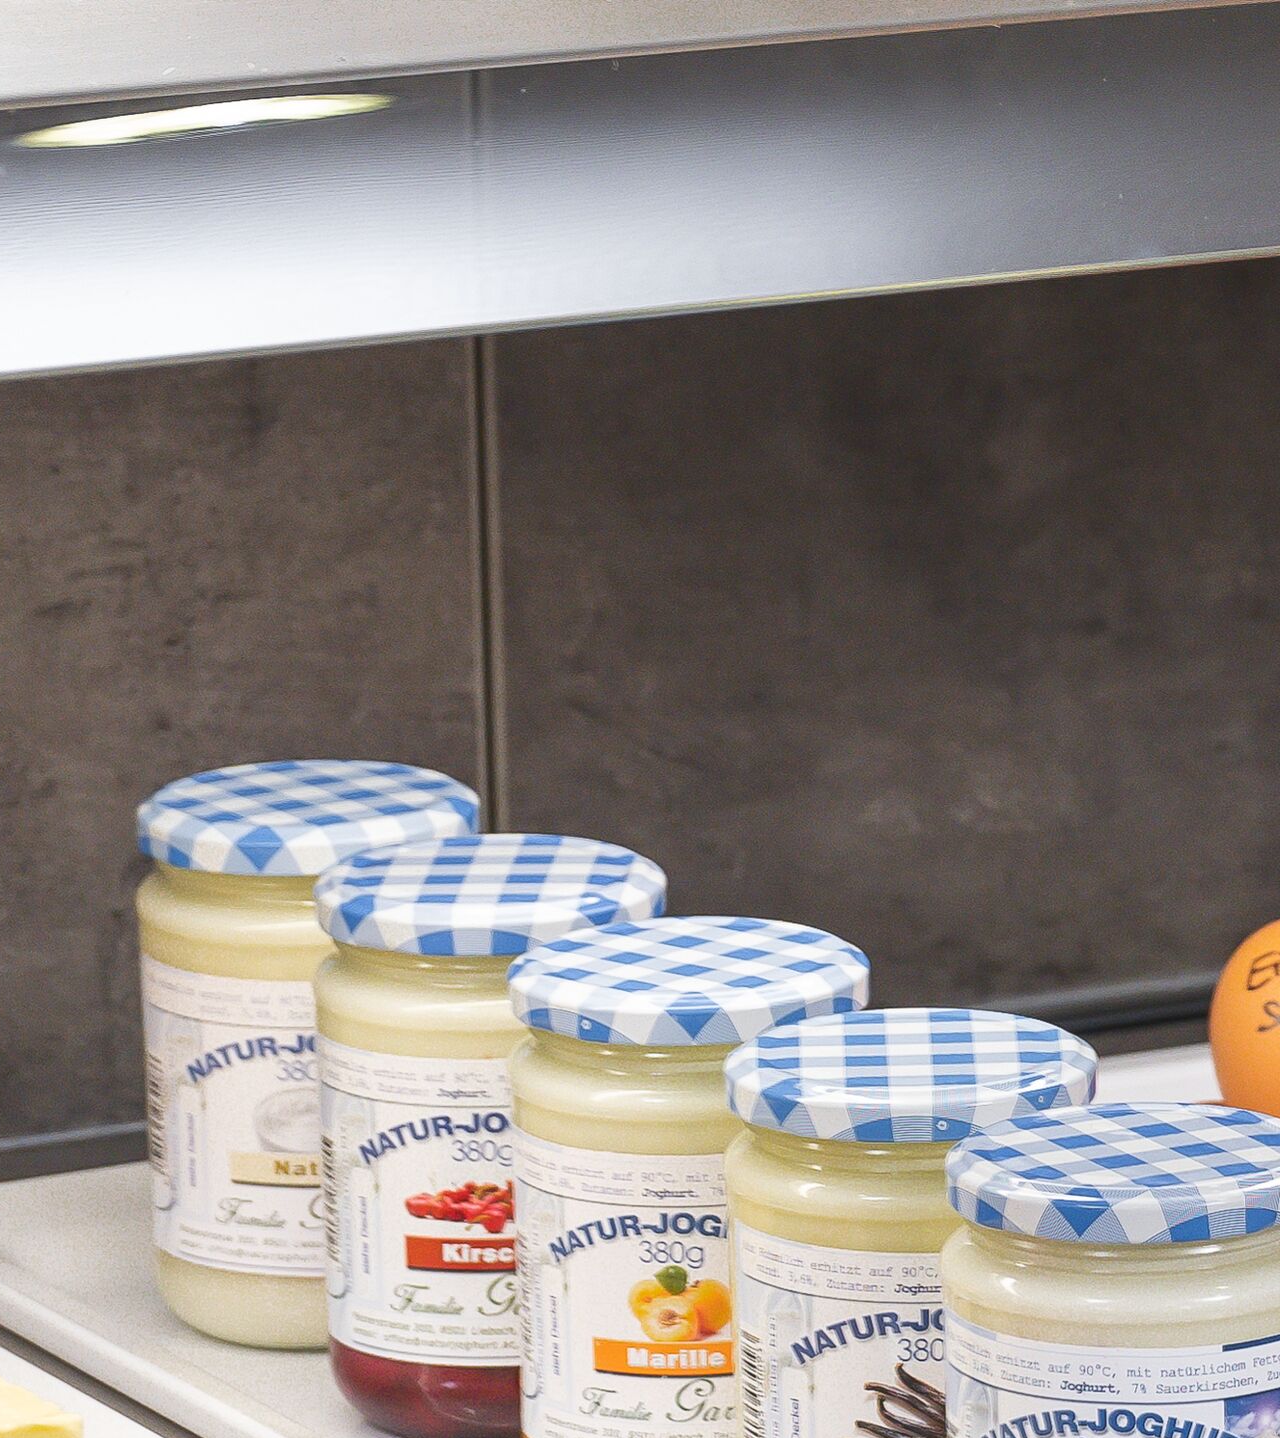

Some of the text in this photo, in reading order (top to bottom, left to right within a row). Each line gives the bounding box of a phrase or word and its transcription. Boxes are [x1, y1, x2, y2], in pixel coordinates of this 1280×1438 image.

[638, 1240, 705, 1269] 380g
[626, 1347, 727, 1369] Marille
[1047, 1362, 1071, 1375] auf
[1078, 1362, 1117, 1379] 90°C,
[1126, 1366, 1152, 1379] mit
[1159, 1361, 1247, 1379] natürlichem
[1059, 1379, 1121, 1395] Joghurt,
[1155, 1374, 1260, 1395] Sauerkirschen,
